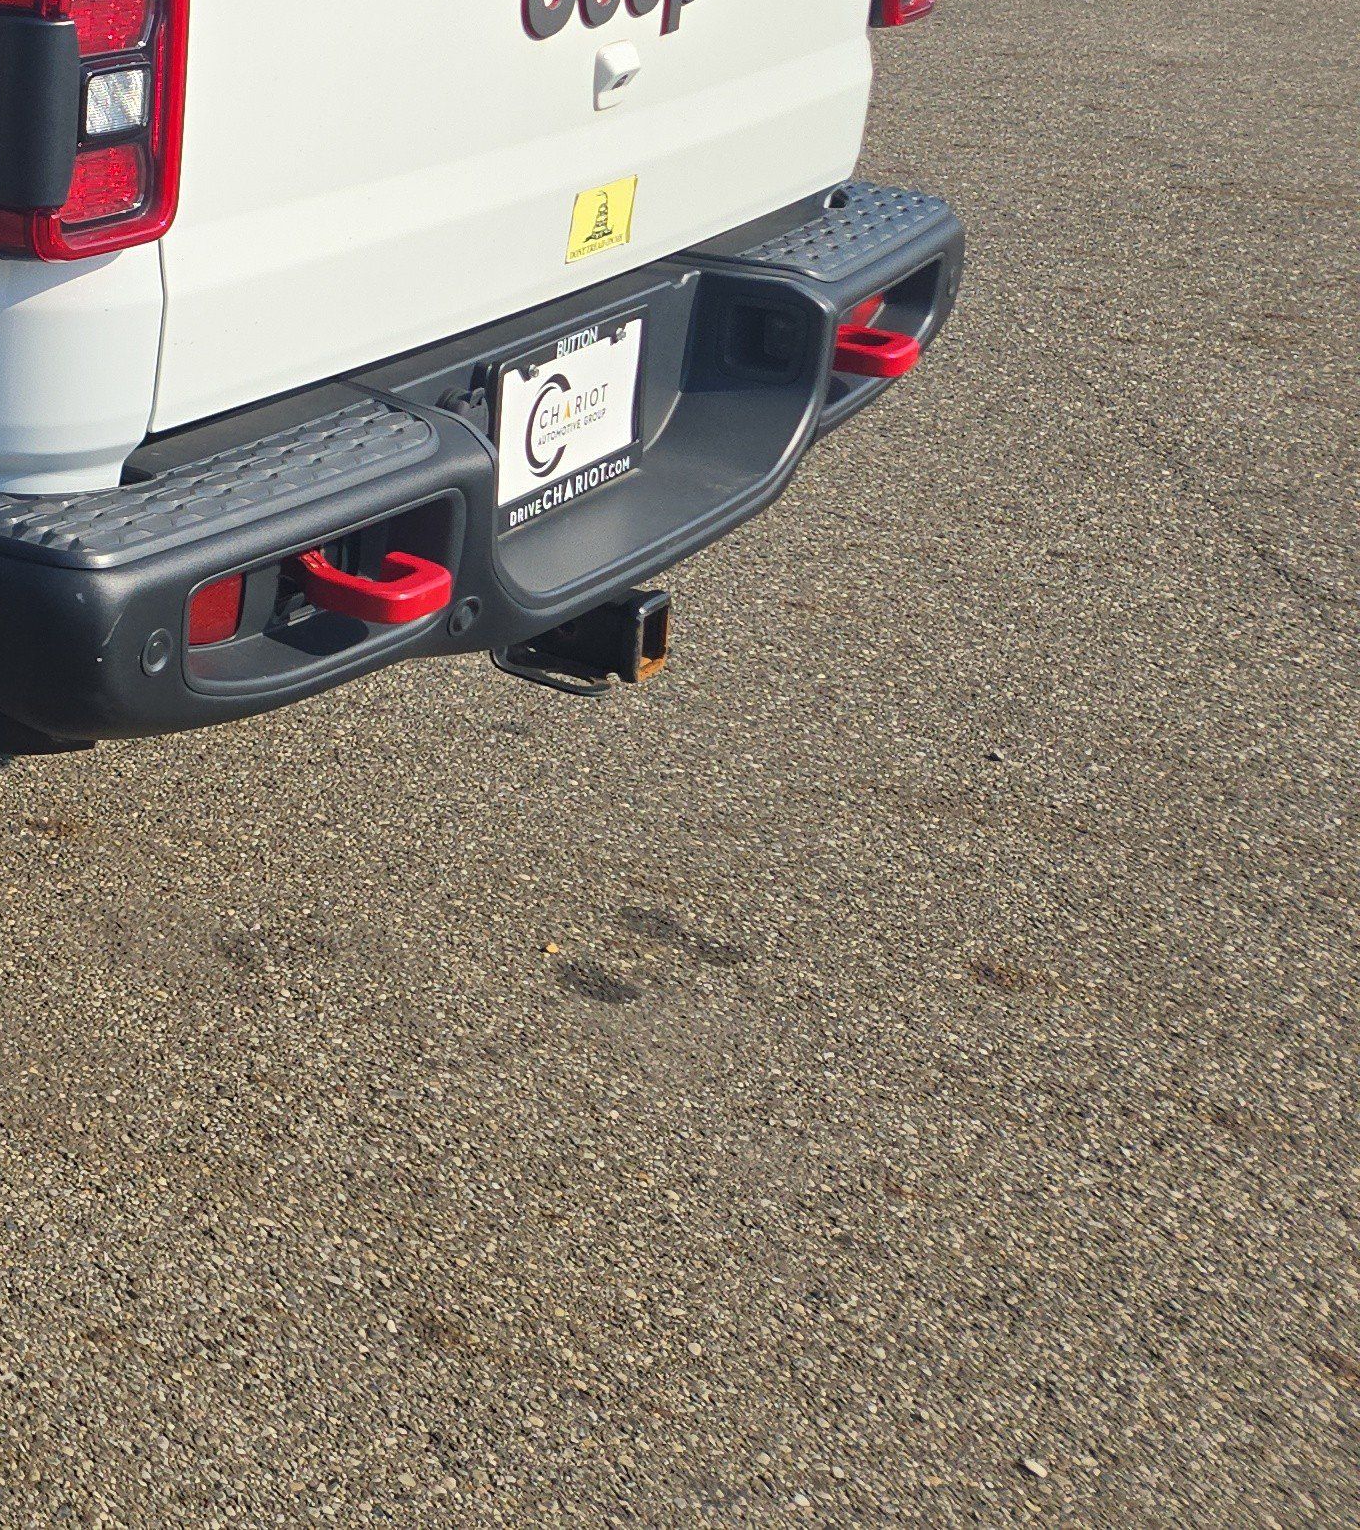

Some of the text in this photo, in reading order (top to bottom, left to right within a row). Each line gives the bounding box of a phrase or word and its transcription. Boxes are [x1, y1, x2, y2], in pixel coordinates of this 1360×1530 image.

[556, 326, 599, 359] BUTTON
[540, 383, 608, 430] CHARIOT
[537, 407, 606, 446] AUTOMOTIVE GROUP
